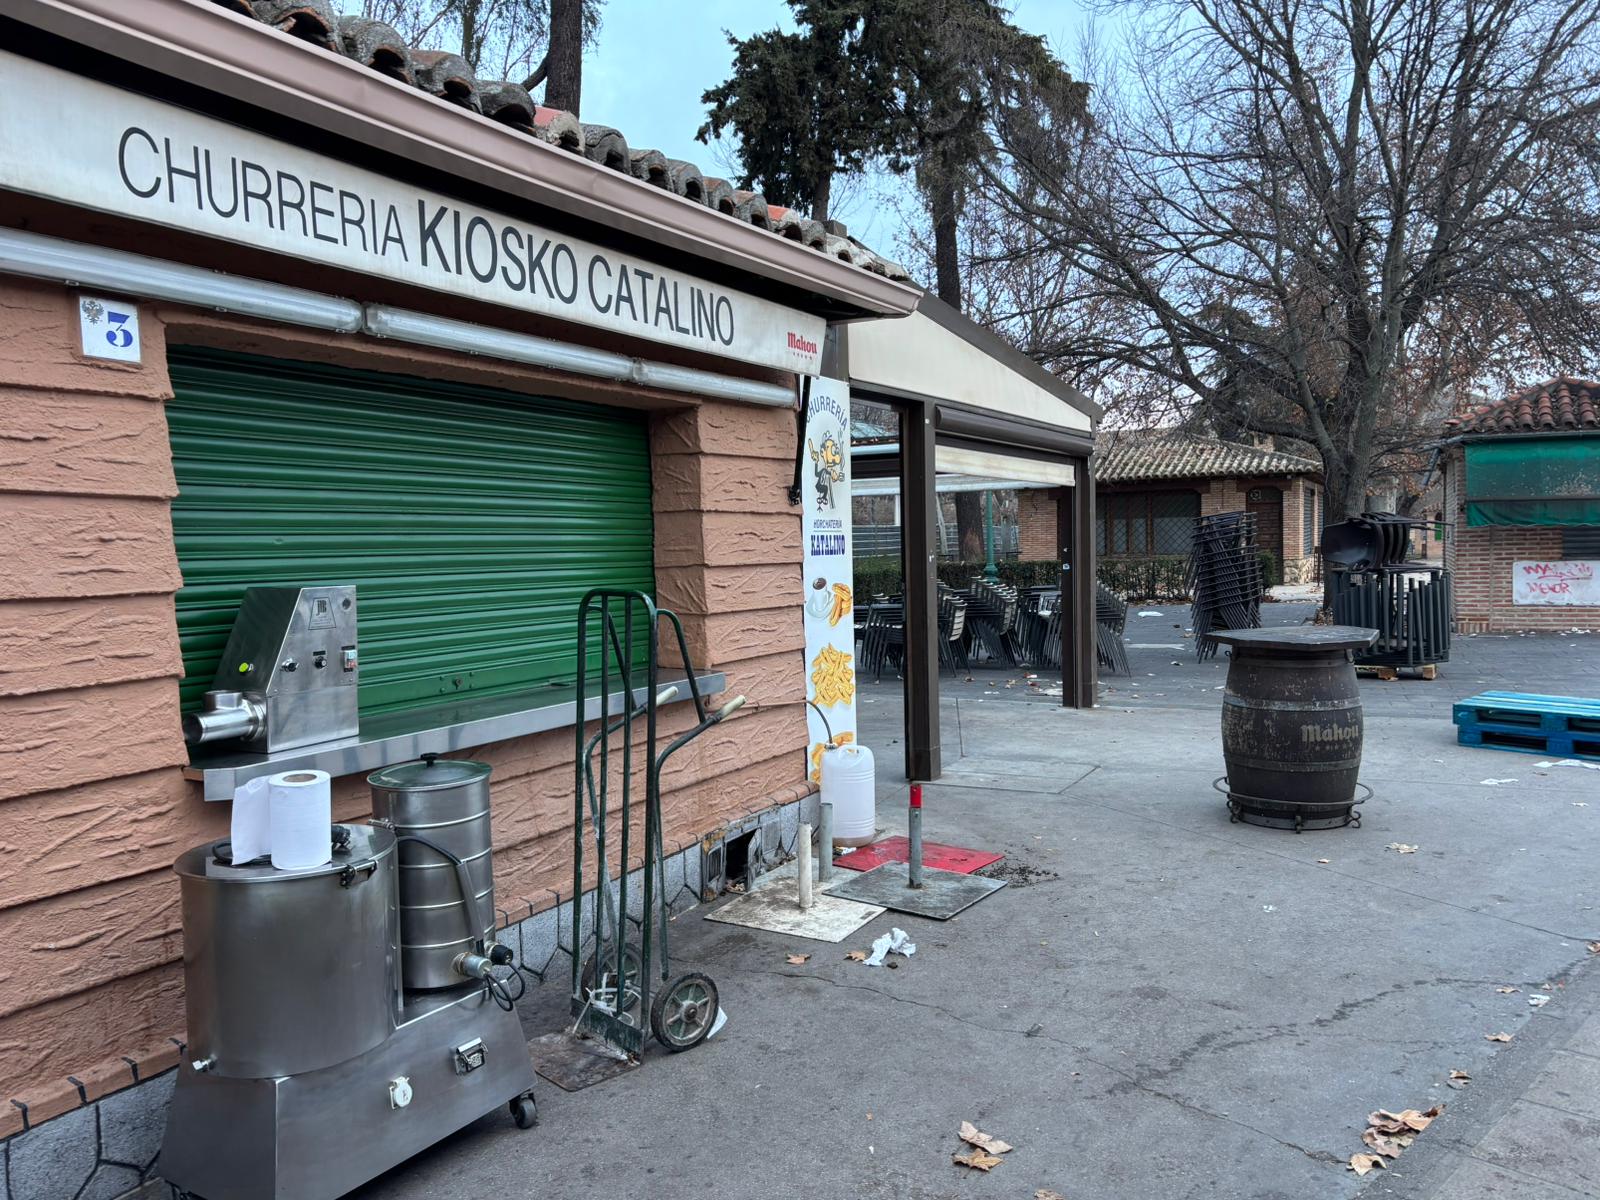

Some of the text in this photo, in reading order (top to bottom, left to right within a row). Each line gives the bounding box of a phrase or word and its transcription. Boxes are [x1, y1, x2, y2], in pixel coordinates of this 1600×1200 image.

[118, 126, 735, 346] CHURRERIA KIOSKO CATALINO
[105, 311, 133, 348] 3
[787, 331, 818, 354] Mahou
[810, 534, 846, 557] KATALINO
[1300, 723, 1359, 745] Mahou
